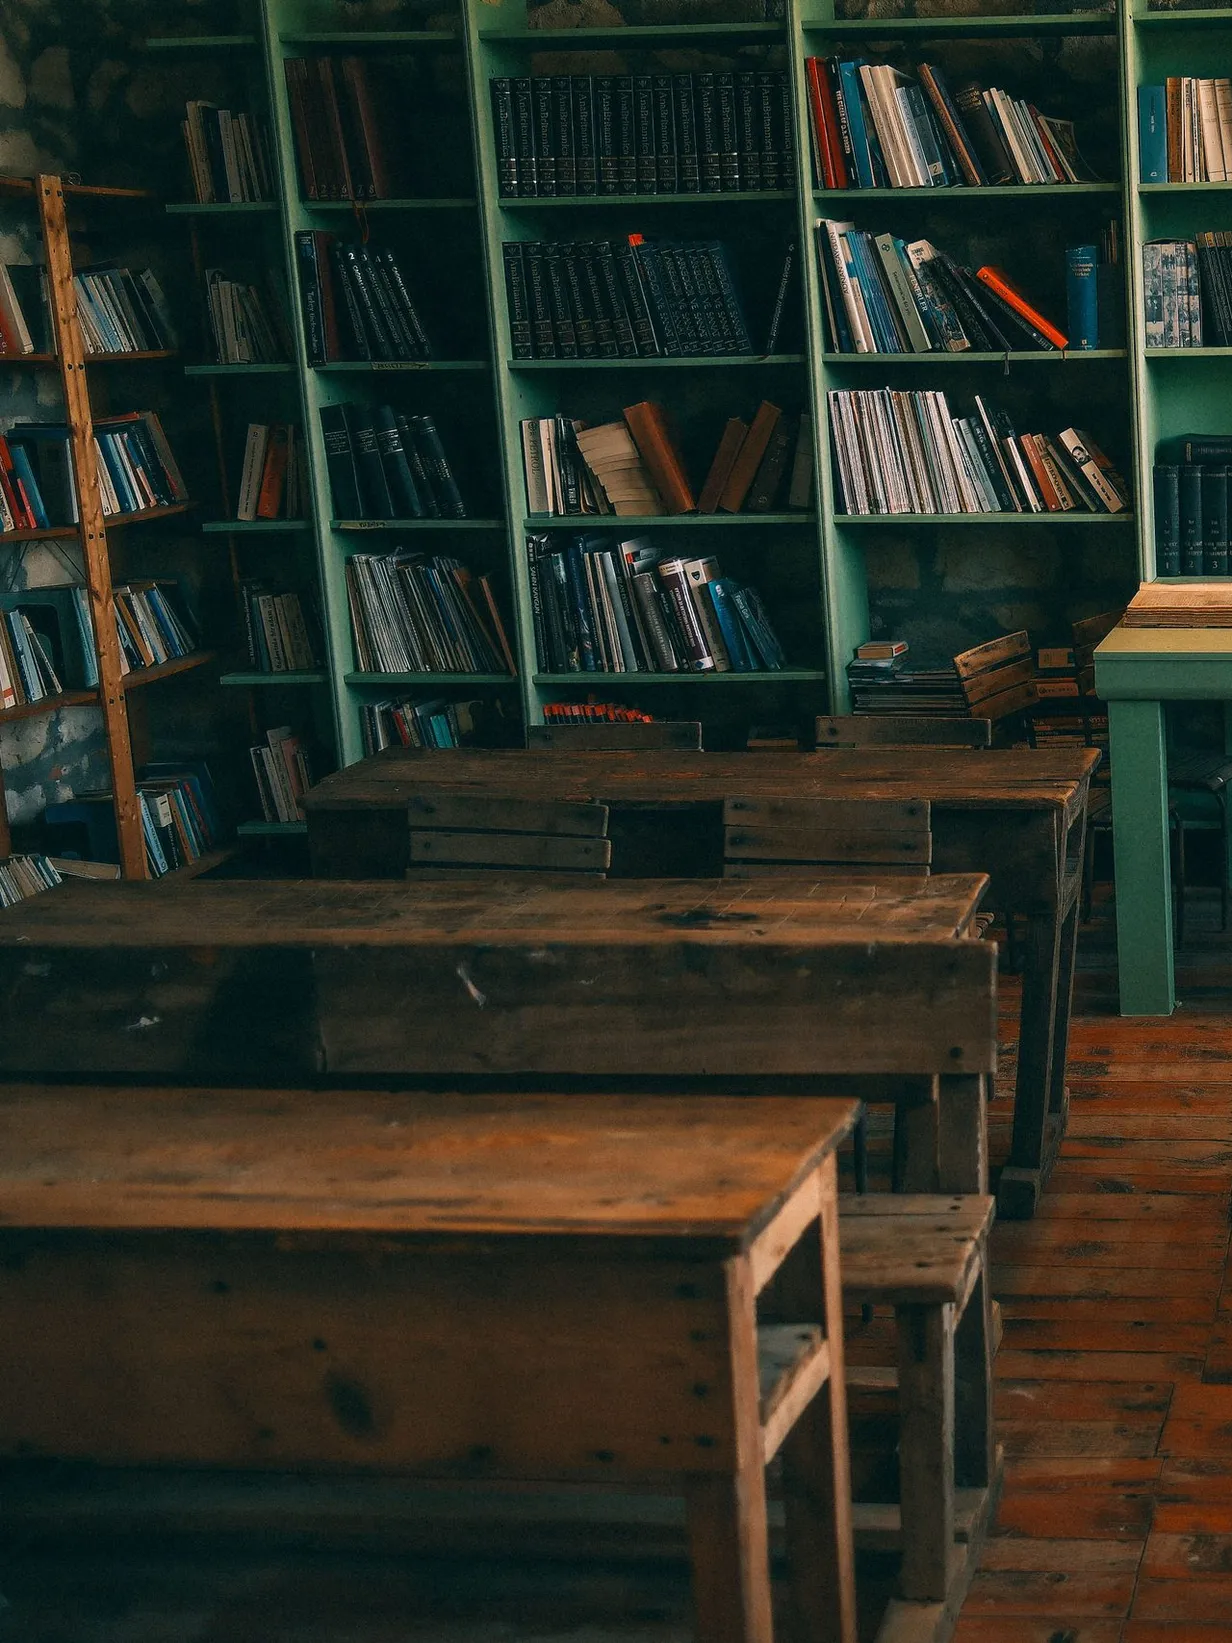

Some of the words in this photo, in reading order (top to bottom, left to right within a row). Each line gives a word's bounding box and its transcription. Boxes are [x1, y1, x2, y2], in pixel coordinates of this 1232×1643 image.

[499, 95, 510, 157] AnaBritannica
[518, 95, 530, 156] AnaBritannica
[539, 94, 550, 156] AnaBritannica
[559, 94, 568, 156] AnaBritannica
[578, 94, 588, 155] AnaBritannica
[620, 93, 629, 154] AnaBritannica
[640, 92, 650, 154] AnaBritannica
[658, 92, 669, 154] AnaBritannica
[680, 91, 692, 152] AnaBritannica
[702, 90, 713, 152] AnaBritannica
[721, 90, 732, 151] AnaBritannica
[742, 89, 753, 150] AnaBritannica
[762, 89, 772, 150] AnaBritannica
[829, 231, 844, 266] SAYGUN
[510, 260, 523, 319] AnaBritannica
[530, 260, 544, 319] AnaBritannica
[549, 259, 565, 319] AnaBritannica
[566, 259, 584, 319] AnaBritannica
[584, 259, 602, 318] AnaBritannica
[601, 259, 621, 318] AnaBritannica
[622, 258, 642, 318] AnaBritannica
[656, 298, 666, 309] VE
[679, 298, 688, 310] VE
[690, 298, 699, 310] VE
[703, 297, 712, 309] VE
[715, 297, 724, 308] VE
[726, 296, 734, 308] VE
[838, 268, 850, 295] ADNAN
[910, 274, 929, 312] FENERLER
[529, 440, 539, 475] PETROL
[1165, 560, 1169, 569] 1
[1188, 560, 1194, 569] 2
[1212, 560, 1218, 569] 3
